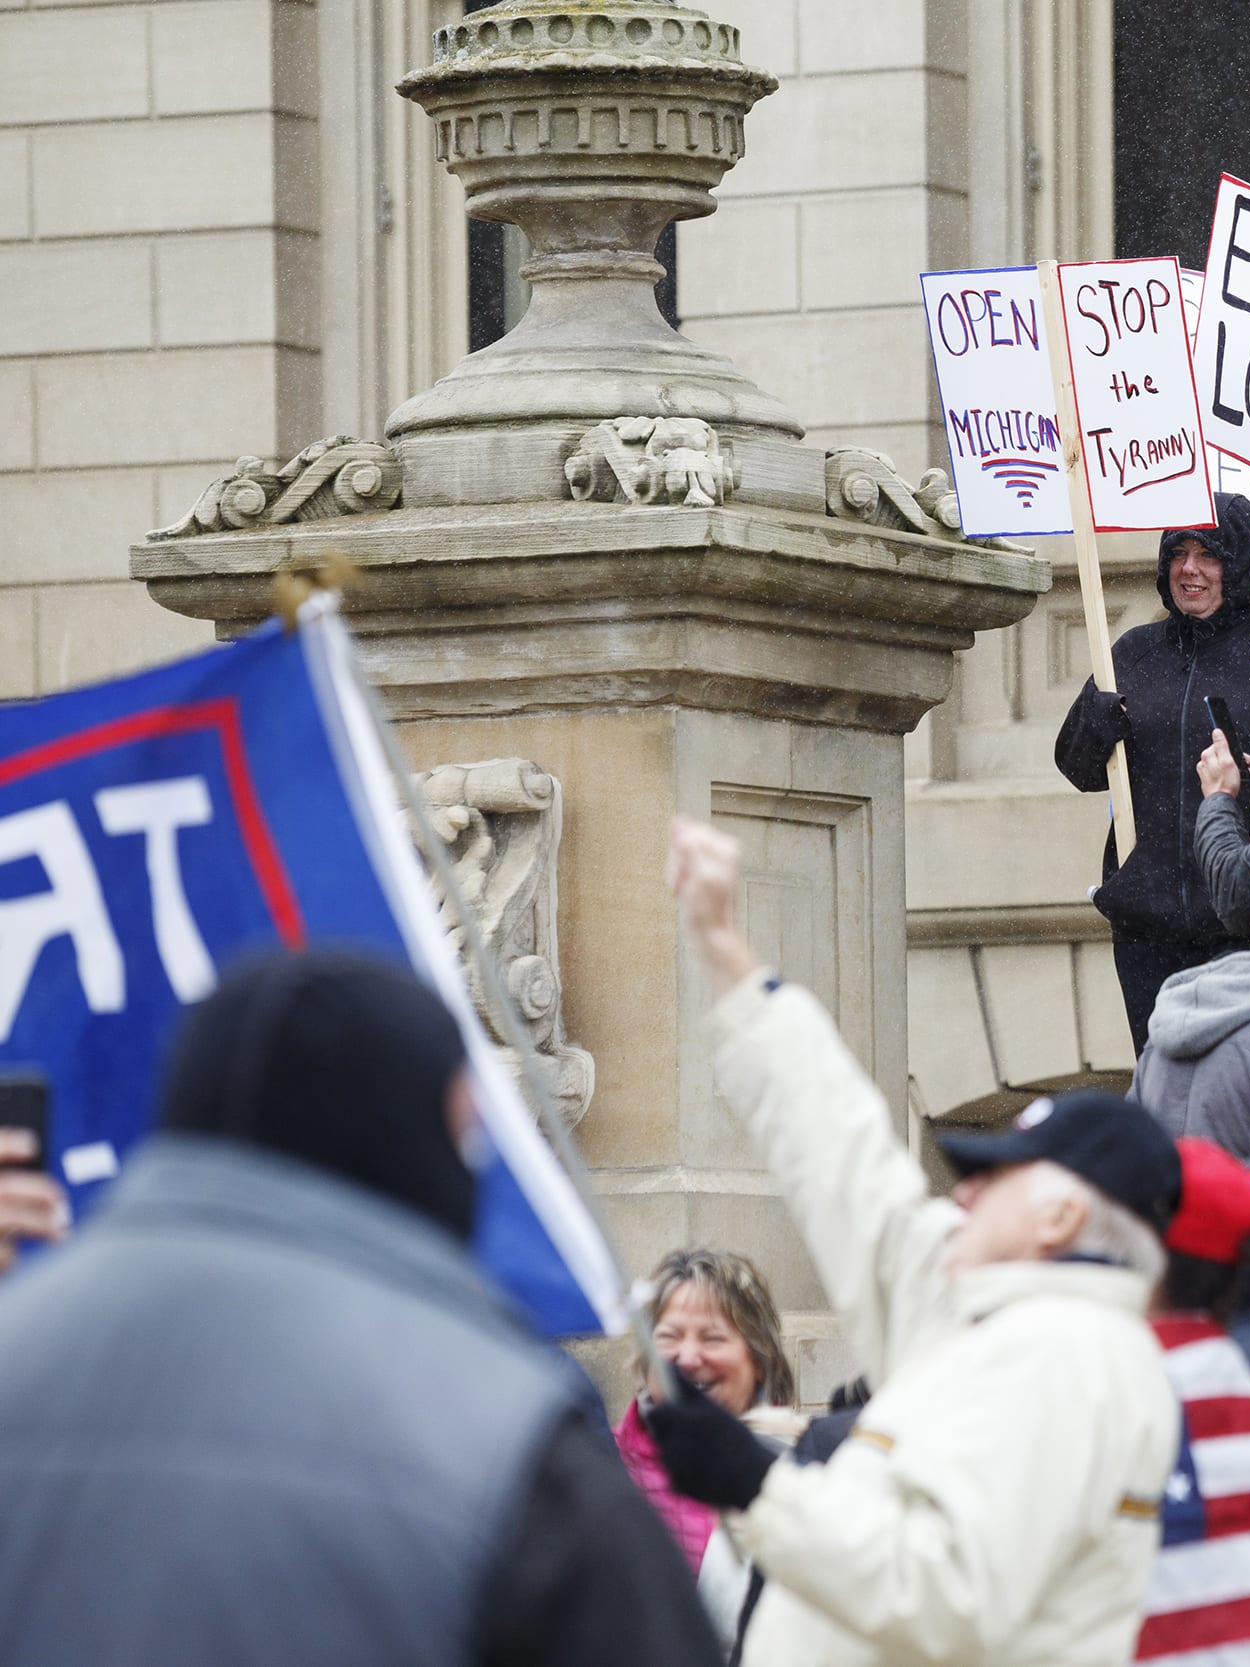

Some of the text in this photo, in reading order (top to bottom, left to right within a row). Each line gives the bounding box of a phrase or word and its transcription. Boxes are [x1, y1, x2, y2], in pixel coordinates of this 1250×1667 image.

[938, 289, 1040, 356] OPEN
[1077, 279, 1171, 357] STOP
[1109, 371, 1160, 402] the
[949, 408, 1062, 458] MICHIGAN
